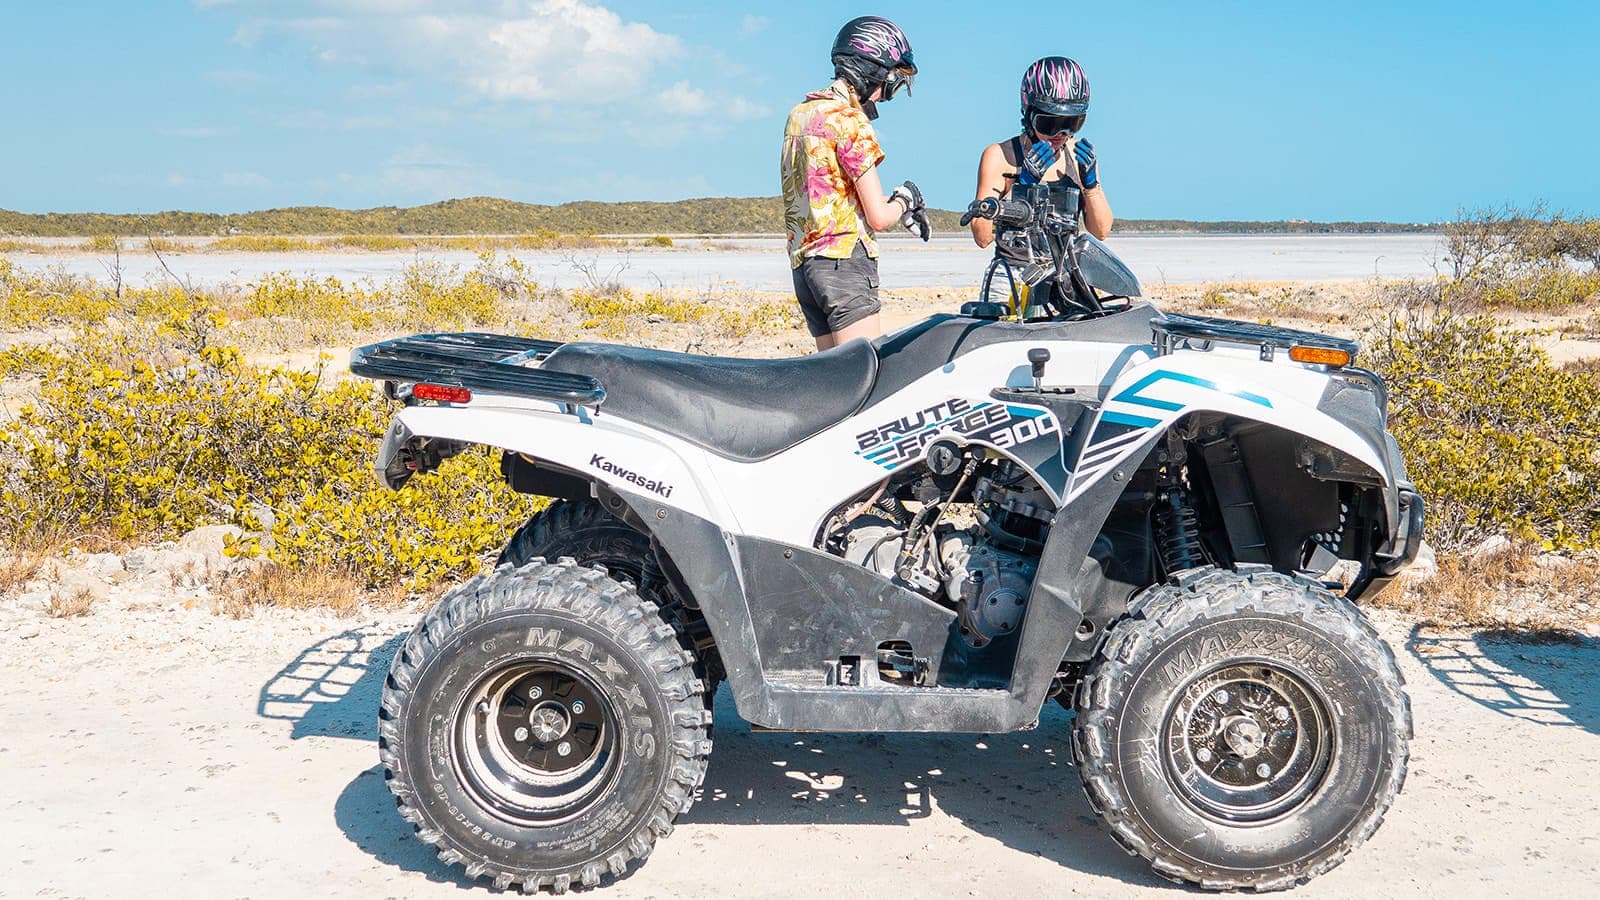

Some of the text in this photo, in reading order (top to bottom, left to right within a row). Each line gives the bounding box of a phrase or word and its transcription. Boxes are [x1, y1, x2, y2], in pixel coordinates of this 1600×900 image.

[857, 398, 971, 450] BRUTE
[589, 453, 674, 498] Kawasaki
[1164, 630, 1340, 682] MAXXIS
[525, 627, 656, 758] MAXXIS
